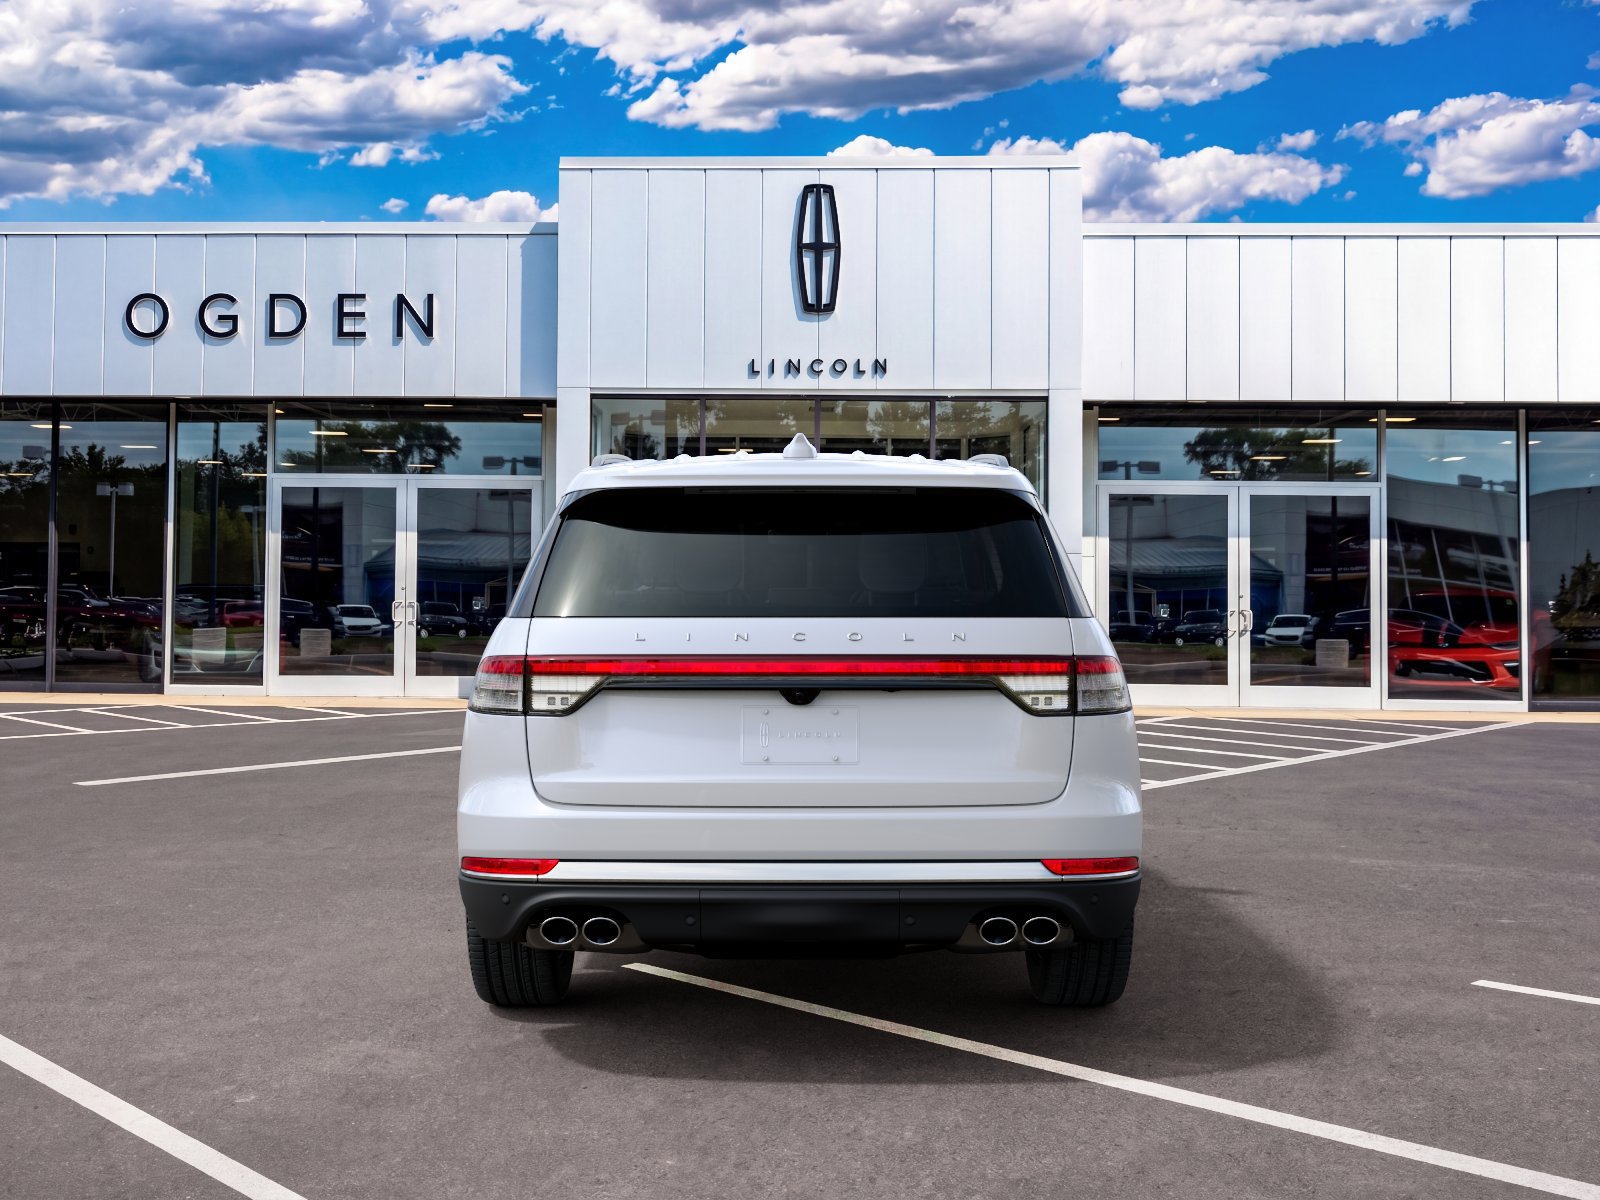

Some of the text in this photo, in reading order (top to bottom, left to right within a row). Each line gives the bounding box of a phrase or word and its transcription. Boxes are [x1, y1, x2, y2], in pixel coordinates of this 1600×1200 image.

[125, 293, 435, 339] OGDEN
[750, 358, 887, 374] LINCOLN
[634, 632, 967, 642] LINCOLN
[778, 730, 841, 739] LINCOLN
